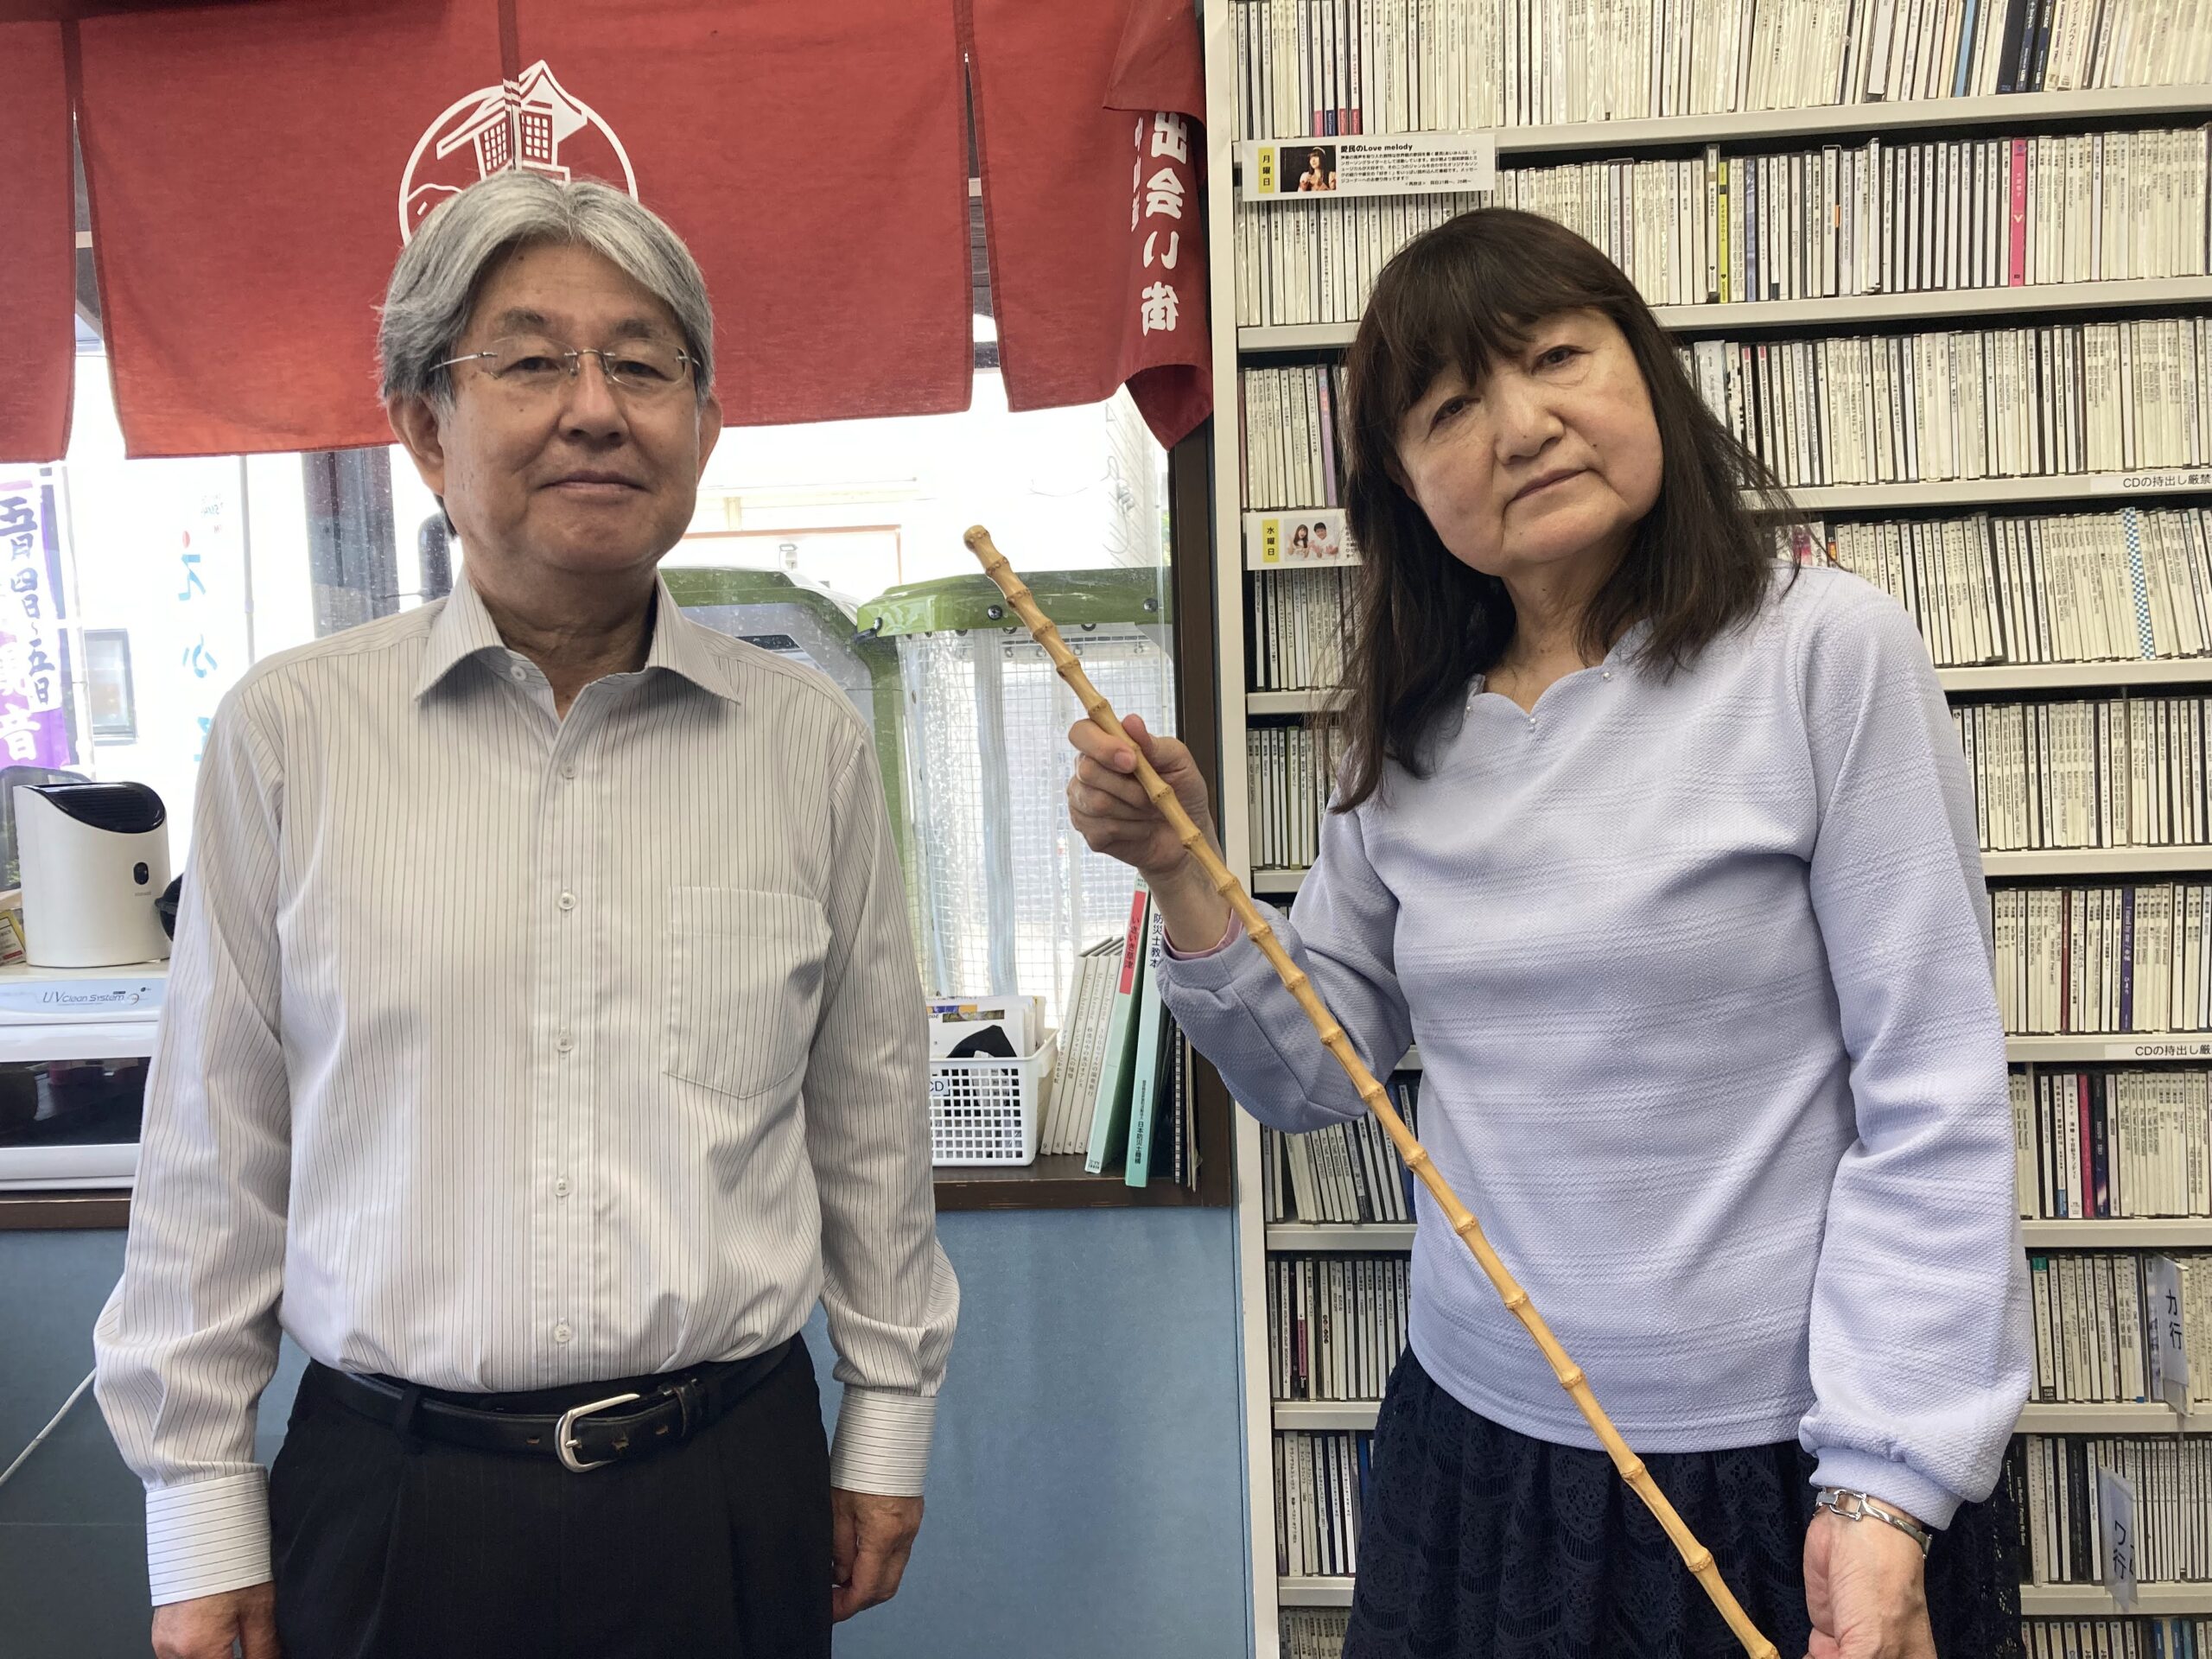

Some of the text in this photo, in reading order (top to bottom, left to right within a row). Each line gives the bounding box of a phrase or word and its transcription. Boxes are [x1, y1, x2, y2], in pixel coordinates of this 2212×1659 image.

[1384, 143, 1413, 151] melody
[1262, 154, 1271, 187] 月曜日
[2123, 474, 2211, 488] CDの持出し厳禁
[1267, 526, 1275, 556] 水曜日
[2134, 1044, 2211, 1056] CDの持出し厳
[2165, 1288, 2183, 1351] カ行
